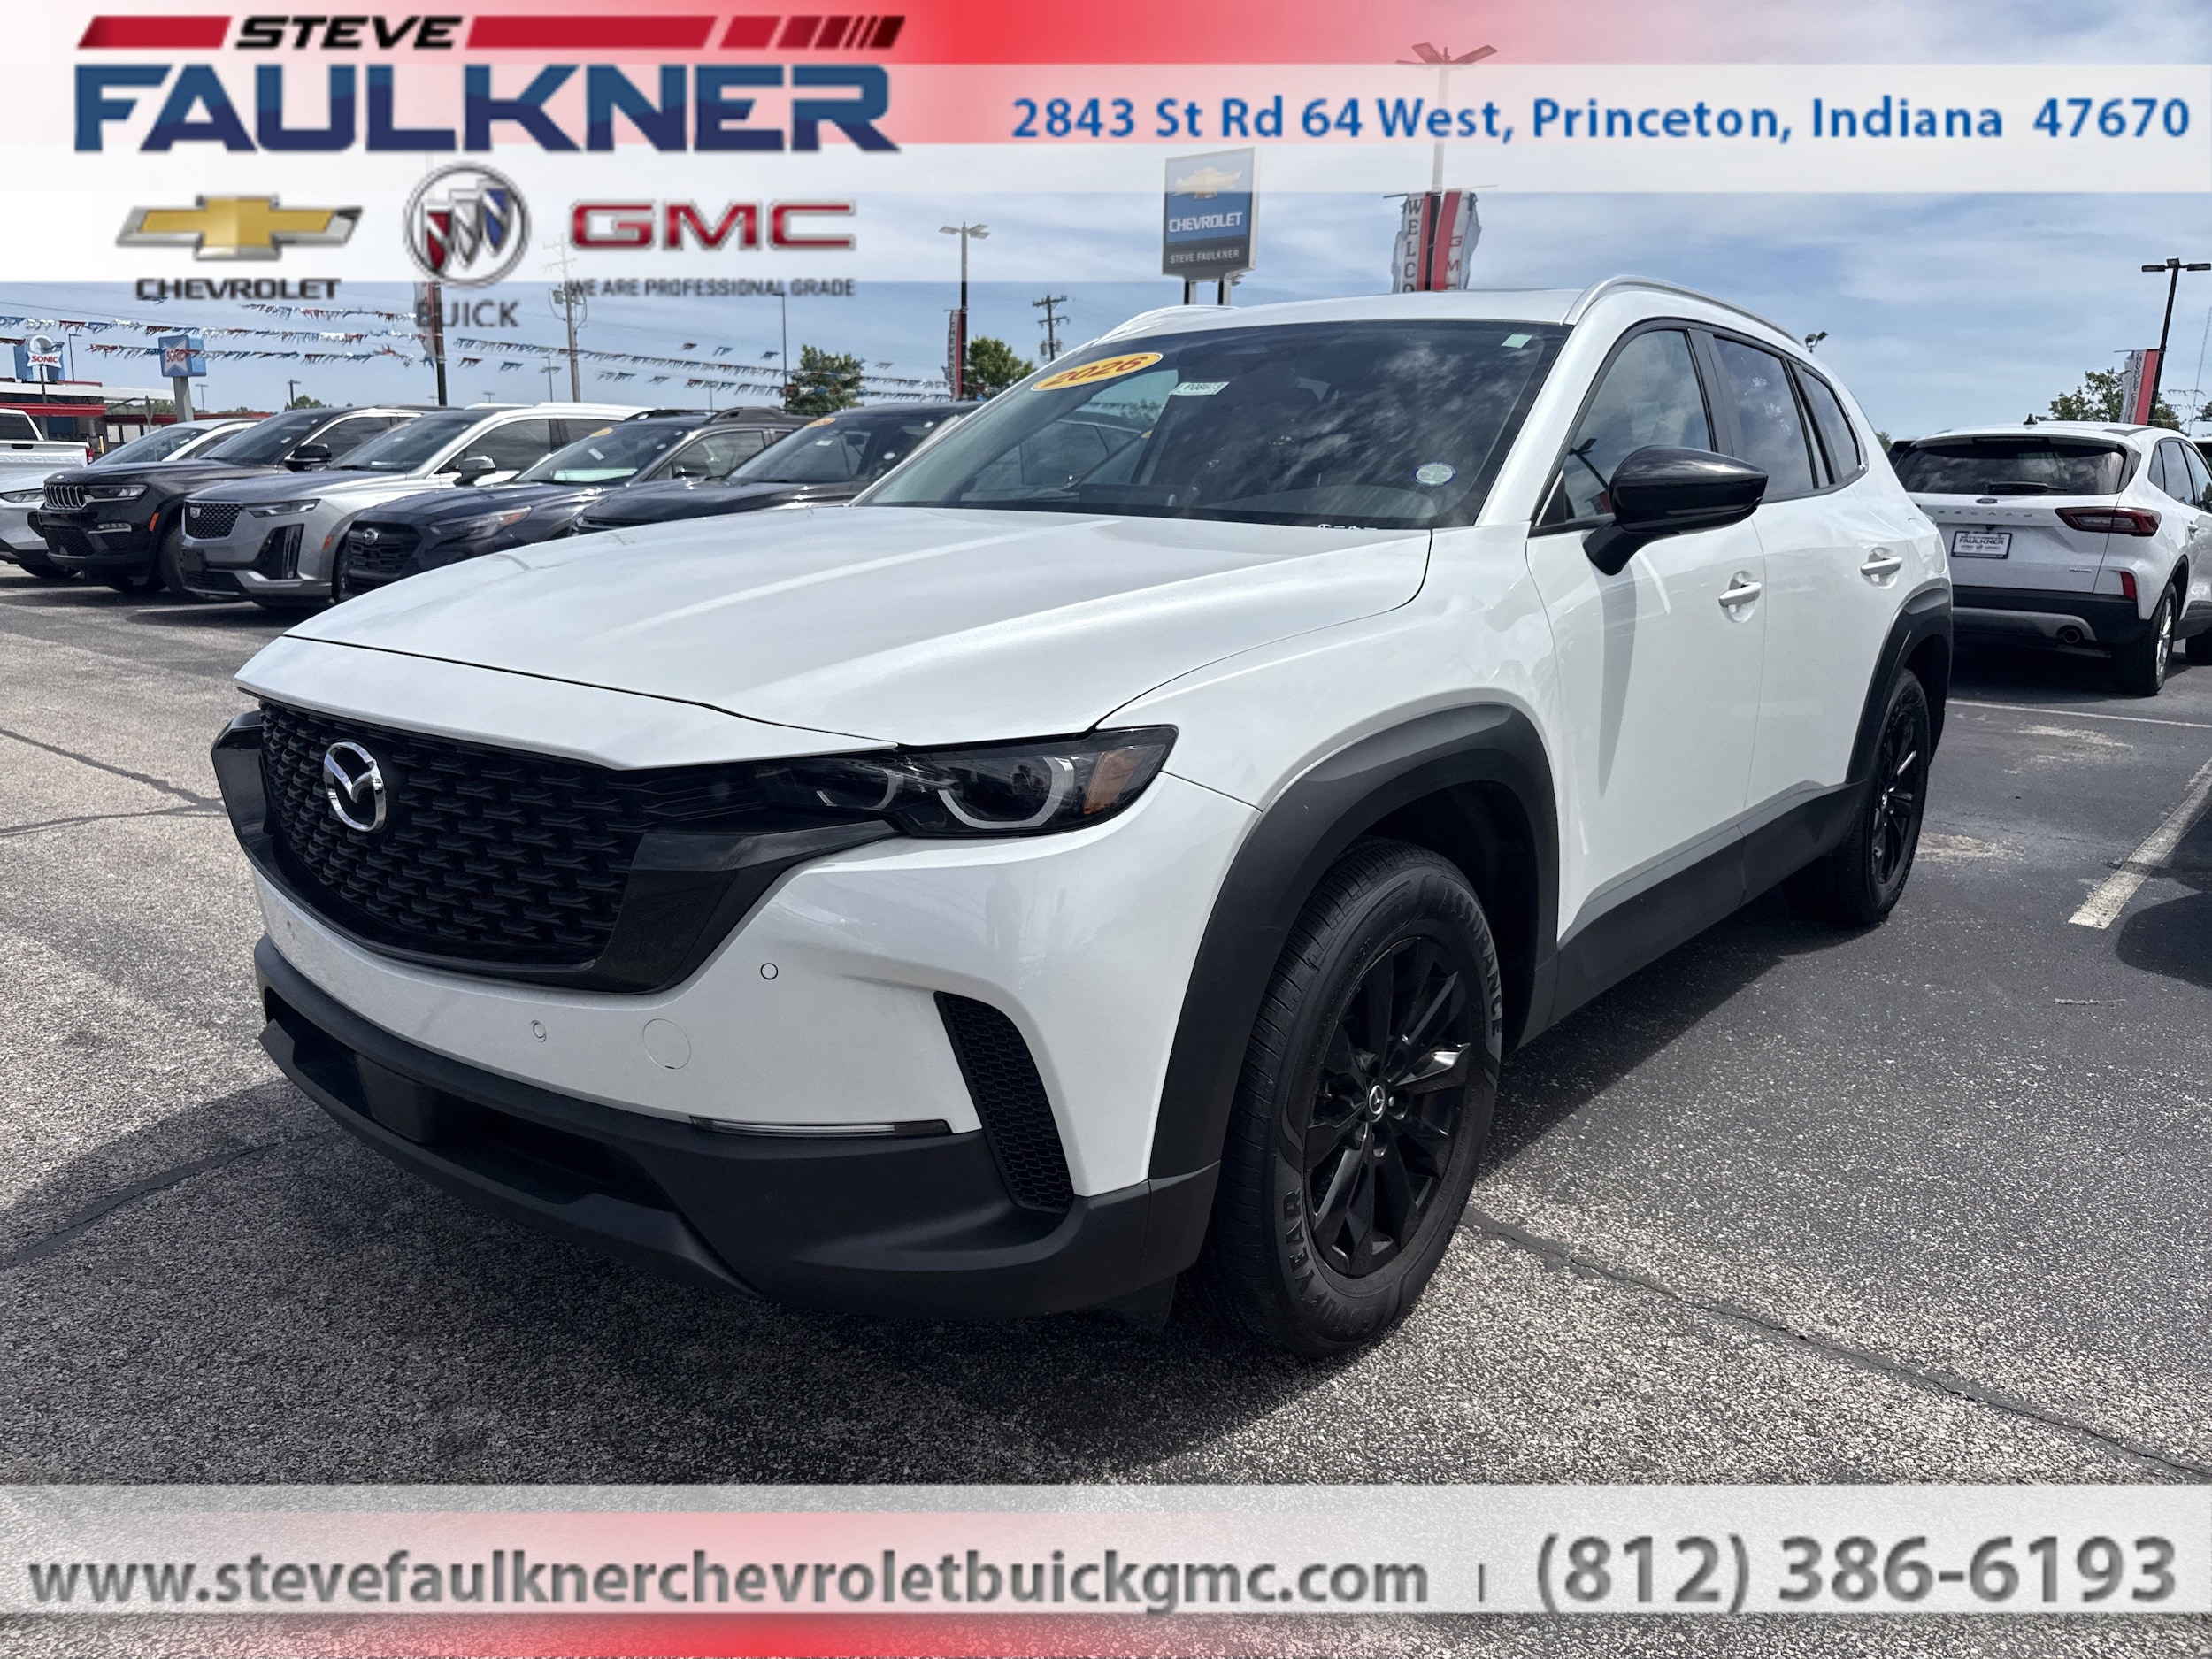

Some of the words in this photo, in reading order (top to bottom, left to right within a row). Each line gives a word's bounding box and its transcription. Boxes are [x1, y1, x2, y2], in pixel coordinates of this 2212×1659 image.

[1169, 212, 1243, 234] CHEVROLET
[1170, 252, 1195, 264] STEVE
[1196, 249, 1240, 263] FAULKNER
[30, 355, 58, 364] SONIC
[1041, 356, 1149, 388] 2026
[1437, 887, 1502, 1037] ASSURANCE
[1283, 1187, 1378, 1335] GOODYEAR
